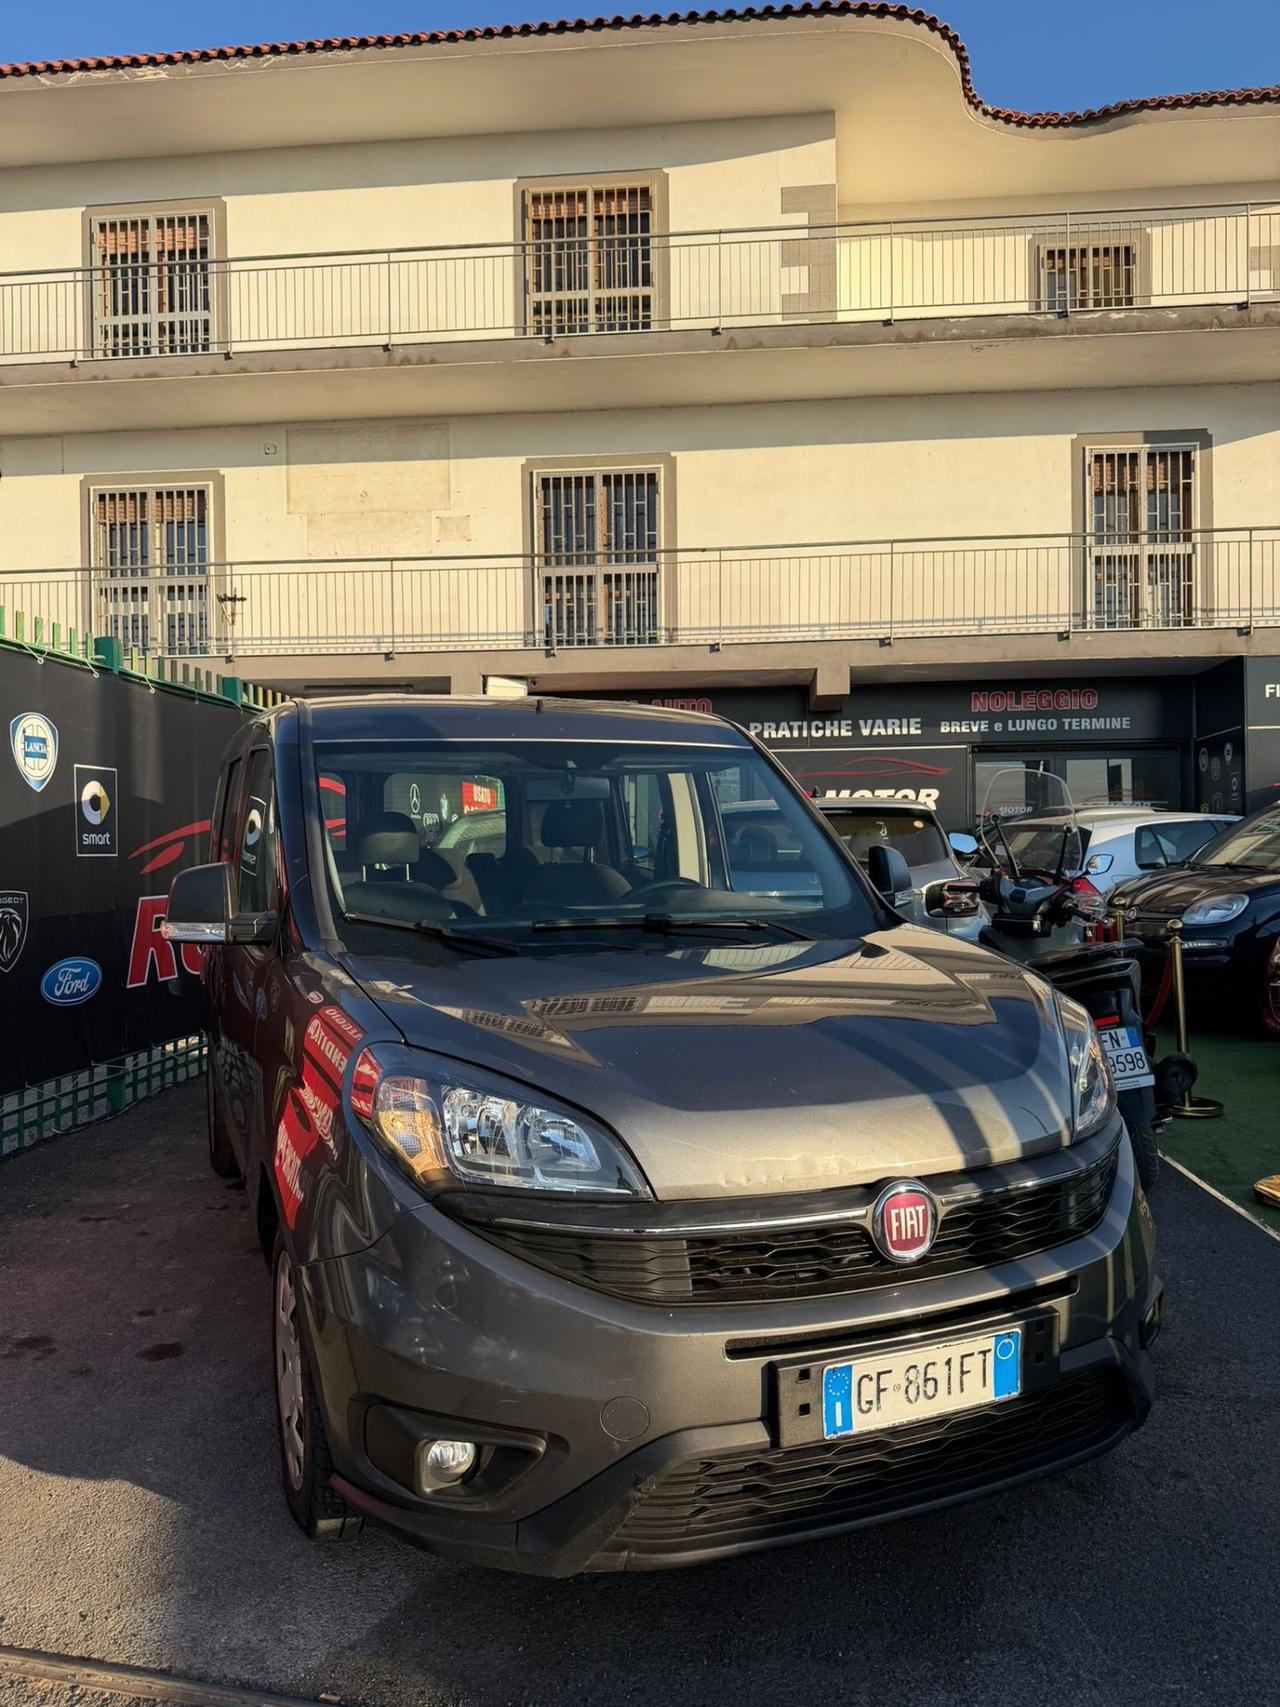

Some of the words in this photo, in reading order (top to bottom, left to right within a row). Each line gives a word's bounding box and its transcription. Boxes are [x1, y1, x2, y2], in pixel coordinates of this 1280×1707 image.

[971, 689, 1098, 712] NOLEGGIO
[749, 720, 851, 738] PRATICHE
[858, 718, 921, 736] VARIE
[940, 720, 989, 733] BREVE
[993, 721, 1002, 731] e
[1007, 718, 1057, 731] LUNGO
[1062, 717, 1131, 731] TERMINE
[82, 832, 111, 846] smart
[54, 967, 90, 997] Ford
[890, 1205, 925, 1241] FIAT
